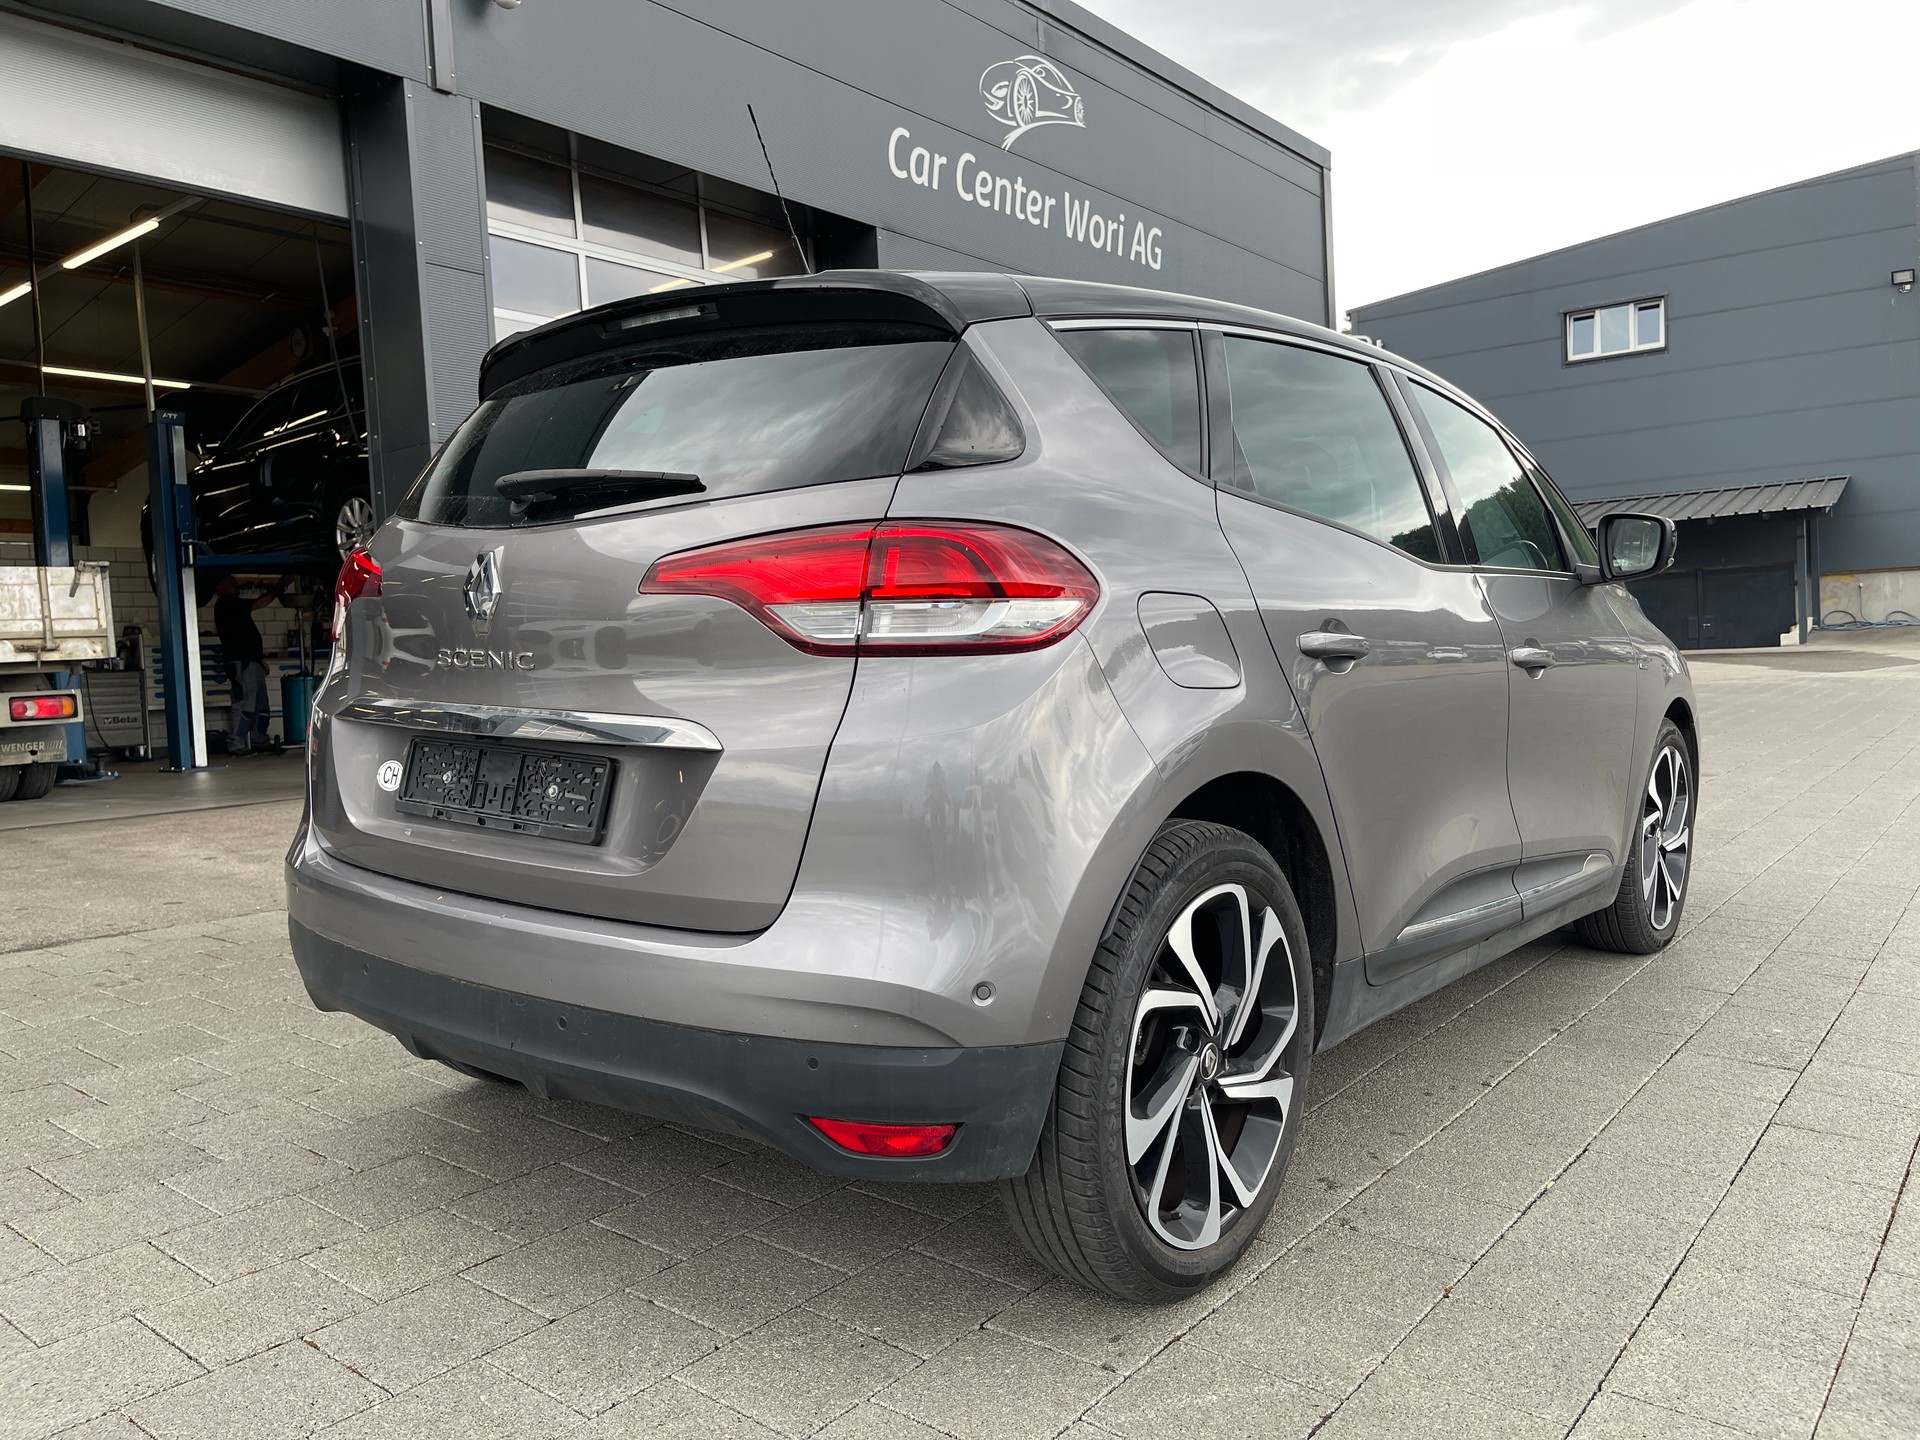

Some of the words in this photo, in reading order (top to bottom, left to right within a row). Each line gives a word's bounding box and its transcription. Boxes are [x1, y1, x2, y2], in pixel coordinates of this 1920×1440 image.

[888, 127, 947, 190] Car
[956, 152, 1056, 229] Center
[1064, 191, 1126, 257] Wori
[1130, 221, 1163, 270] AG
[437, 647, 536, 671] SCENIC
[112, 715, 138, 725] Beta
[0, 741, 45, 753] WENGER
[383, 765, 400, 785] CH
